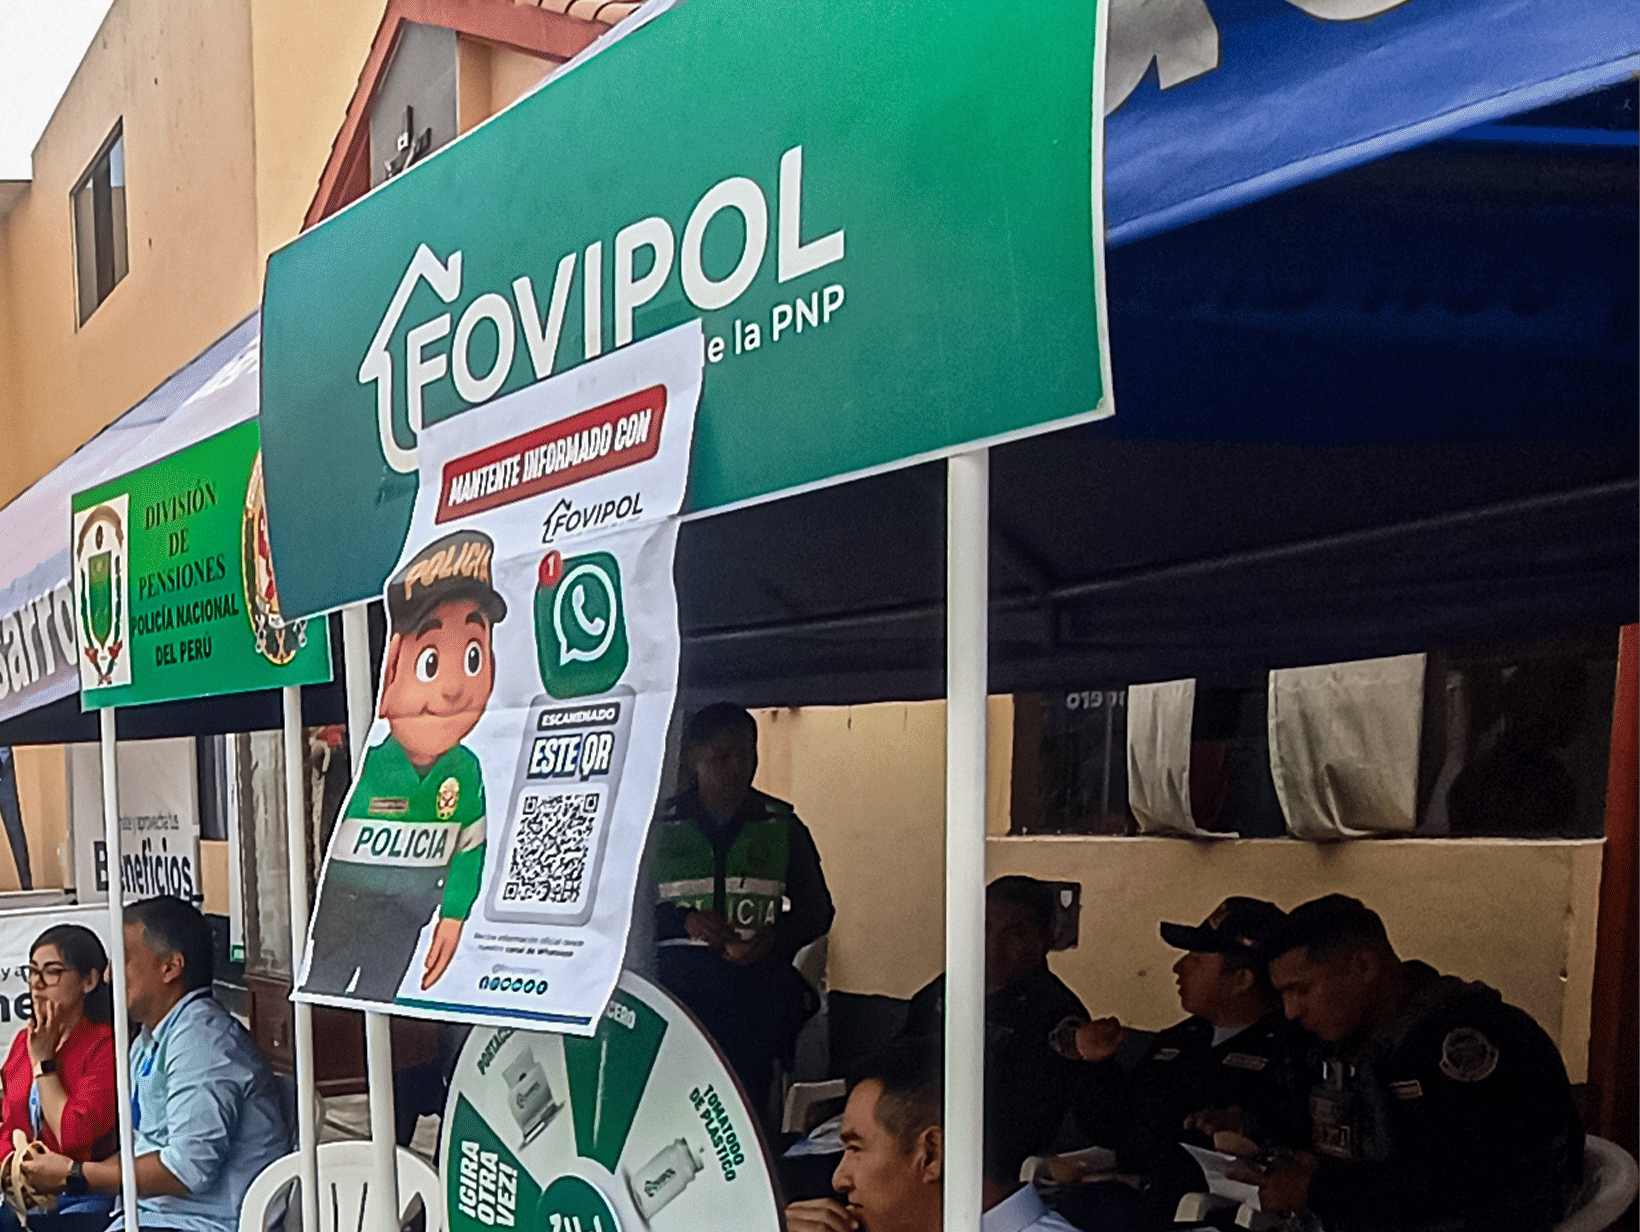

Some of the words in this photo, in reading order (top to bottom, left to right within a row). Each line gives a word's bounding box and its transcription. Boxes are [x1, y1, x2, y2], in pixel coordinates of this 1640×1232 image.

[407, 145, 845, 434] FOVIPOL
[707, 337, 725, 363] e
[734, 319, 761, 355] la
[772, 284, 845, 341] PNP
[448, 454, 521, 507] MANTENTE
[522, 422, 612, 483] INFORMADO
[614, 408, 652, 451] CON
[145, 479, 218, 530] DIVISIÓN
[548, 492, 644, 539] FOVIPOL
[168, 528, 190, 557] DE
[138, 554, 226, 600] PENSIONES
[176, 593, 239, 628] NACIONAL
[155, 640, 177, 667] DEL
[180, 631, 212, 662] PERÚ
[528, 736, 581, 775] ESTE
[581, 733, 614, 777] QR
[352, 826, 449, 860] POLICIA
[93, 836, 193, 899] Bneficios
[1, 967, 11, 982] y
[689, 1086, 706, 1112] DE
[703, 1083, 745, 1166] TOMATODO
[477, 1151, 499, 1226] OTRA
